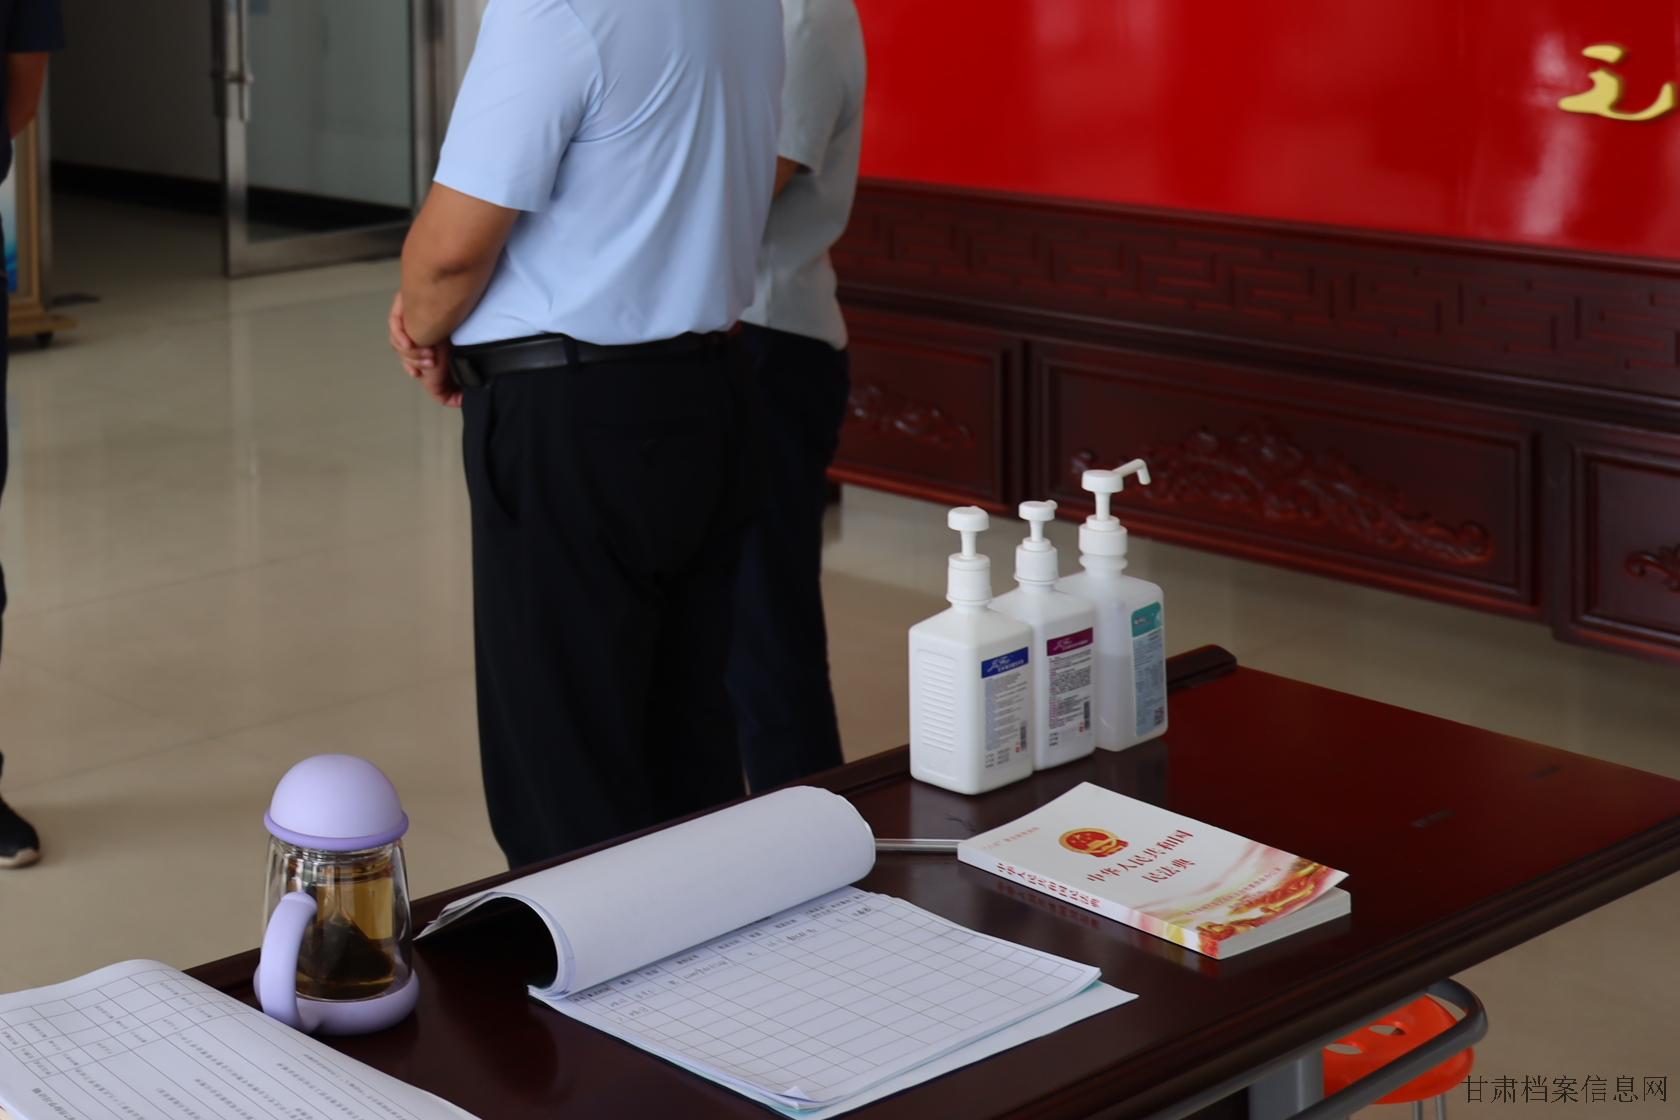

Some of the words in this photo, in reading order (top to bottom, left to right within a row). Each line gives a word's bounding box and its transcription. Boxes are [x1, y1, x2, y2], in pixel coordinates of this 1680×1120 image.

[1086, 829, 1193, 884] 中华人民共和国
[1142, 857, 1195, 885] 民法典
